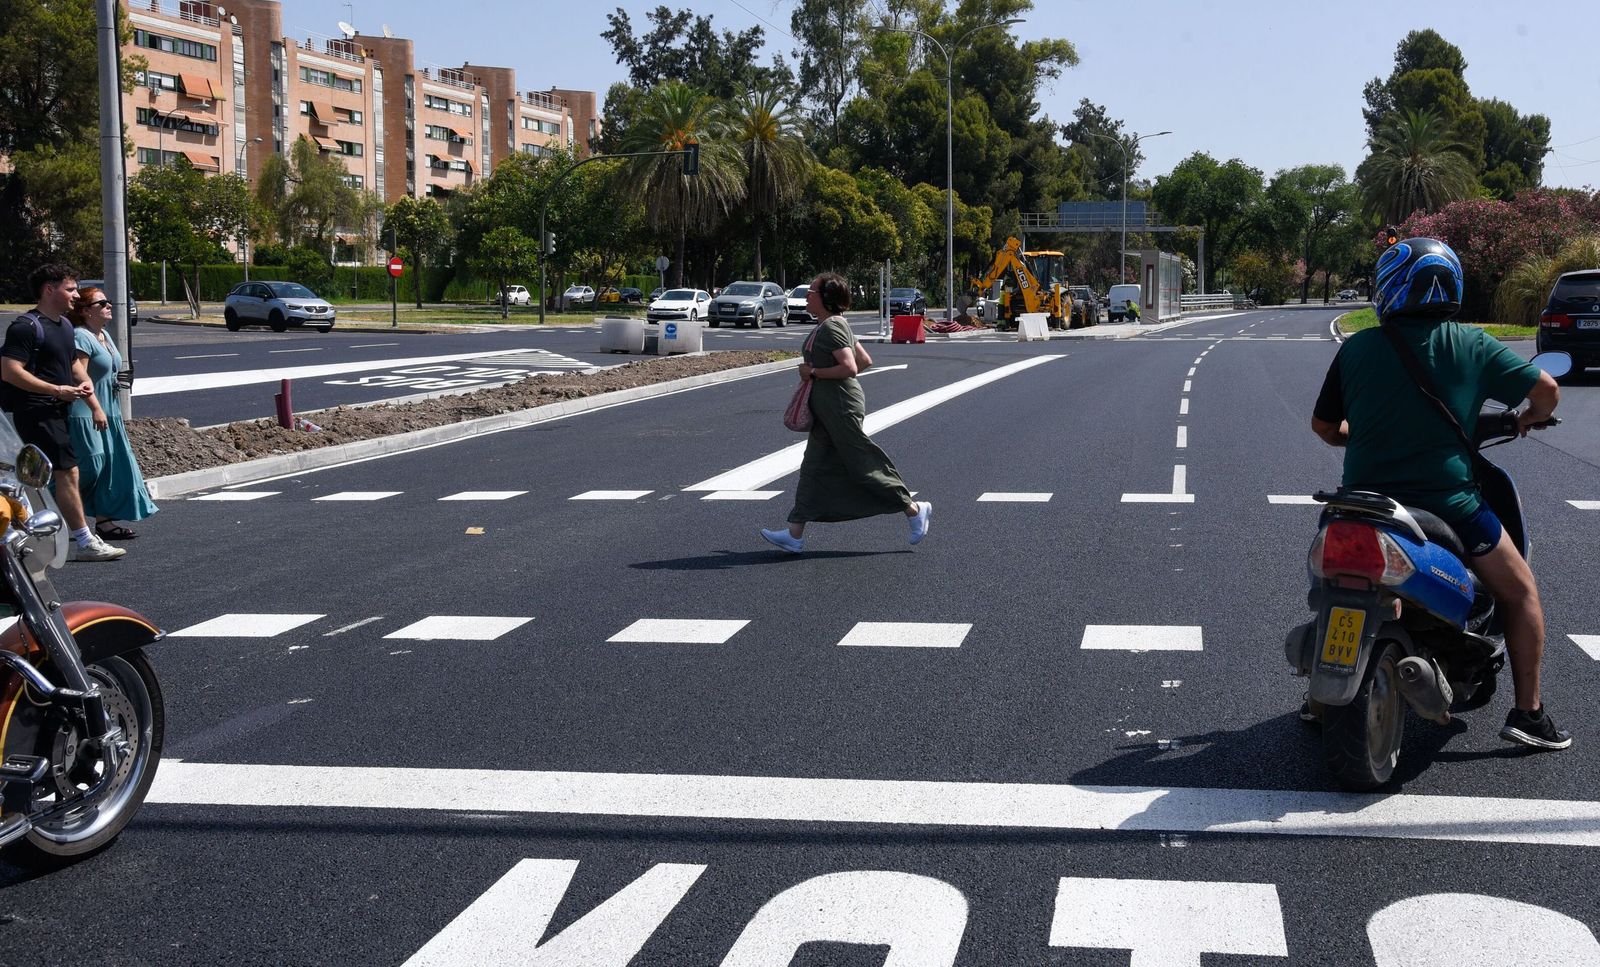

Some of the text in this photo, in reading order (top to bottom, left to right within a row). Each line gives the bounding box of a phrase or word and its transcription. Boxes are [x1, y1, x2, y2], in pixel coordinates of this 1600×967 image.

[1016, 269, 1029, 288] JCB
[323, 375, 488, 389] BUS
[1331, 629, 1356, 643] 410
